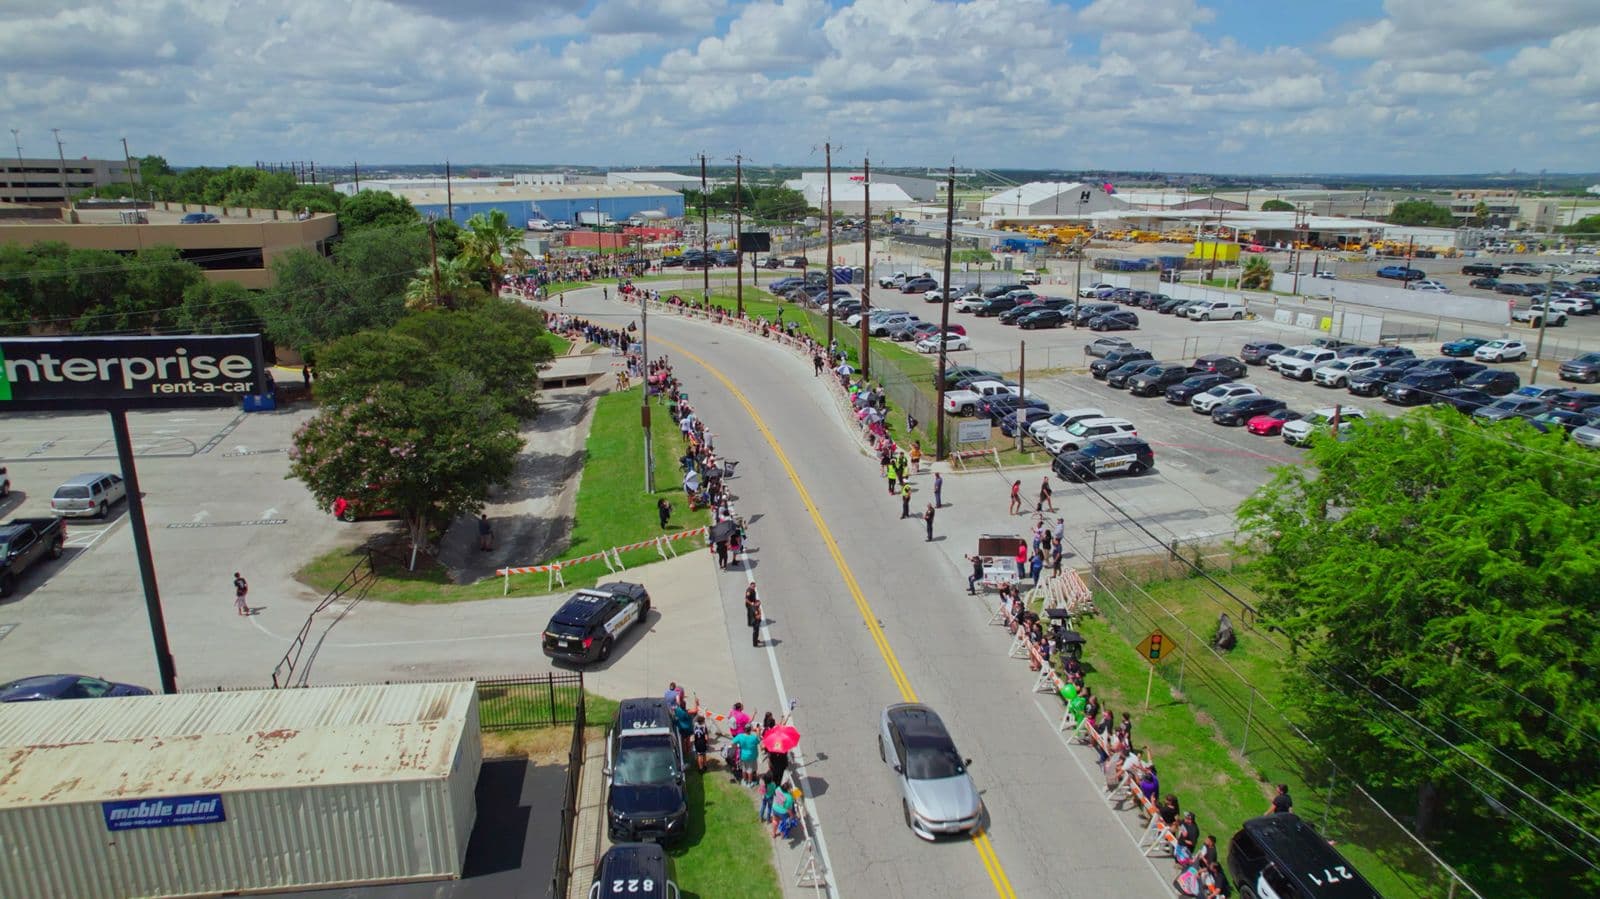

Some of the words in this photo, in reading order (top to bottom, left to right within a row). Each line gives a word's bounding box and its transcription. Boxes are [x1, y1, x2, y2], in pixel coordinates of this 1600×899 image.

[0, 348, 253, 389] nterprise
[152, 380, 254, 394] rent-a-car
[632, 720, 657, 729] 779
[110, 801, 173, 820] mobile
[175, 798, 220, 815] mini
[1307, 865, 1354, 887] 271
[613, 880, 654, 892] 822
